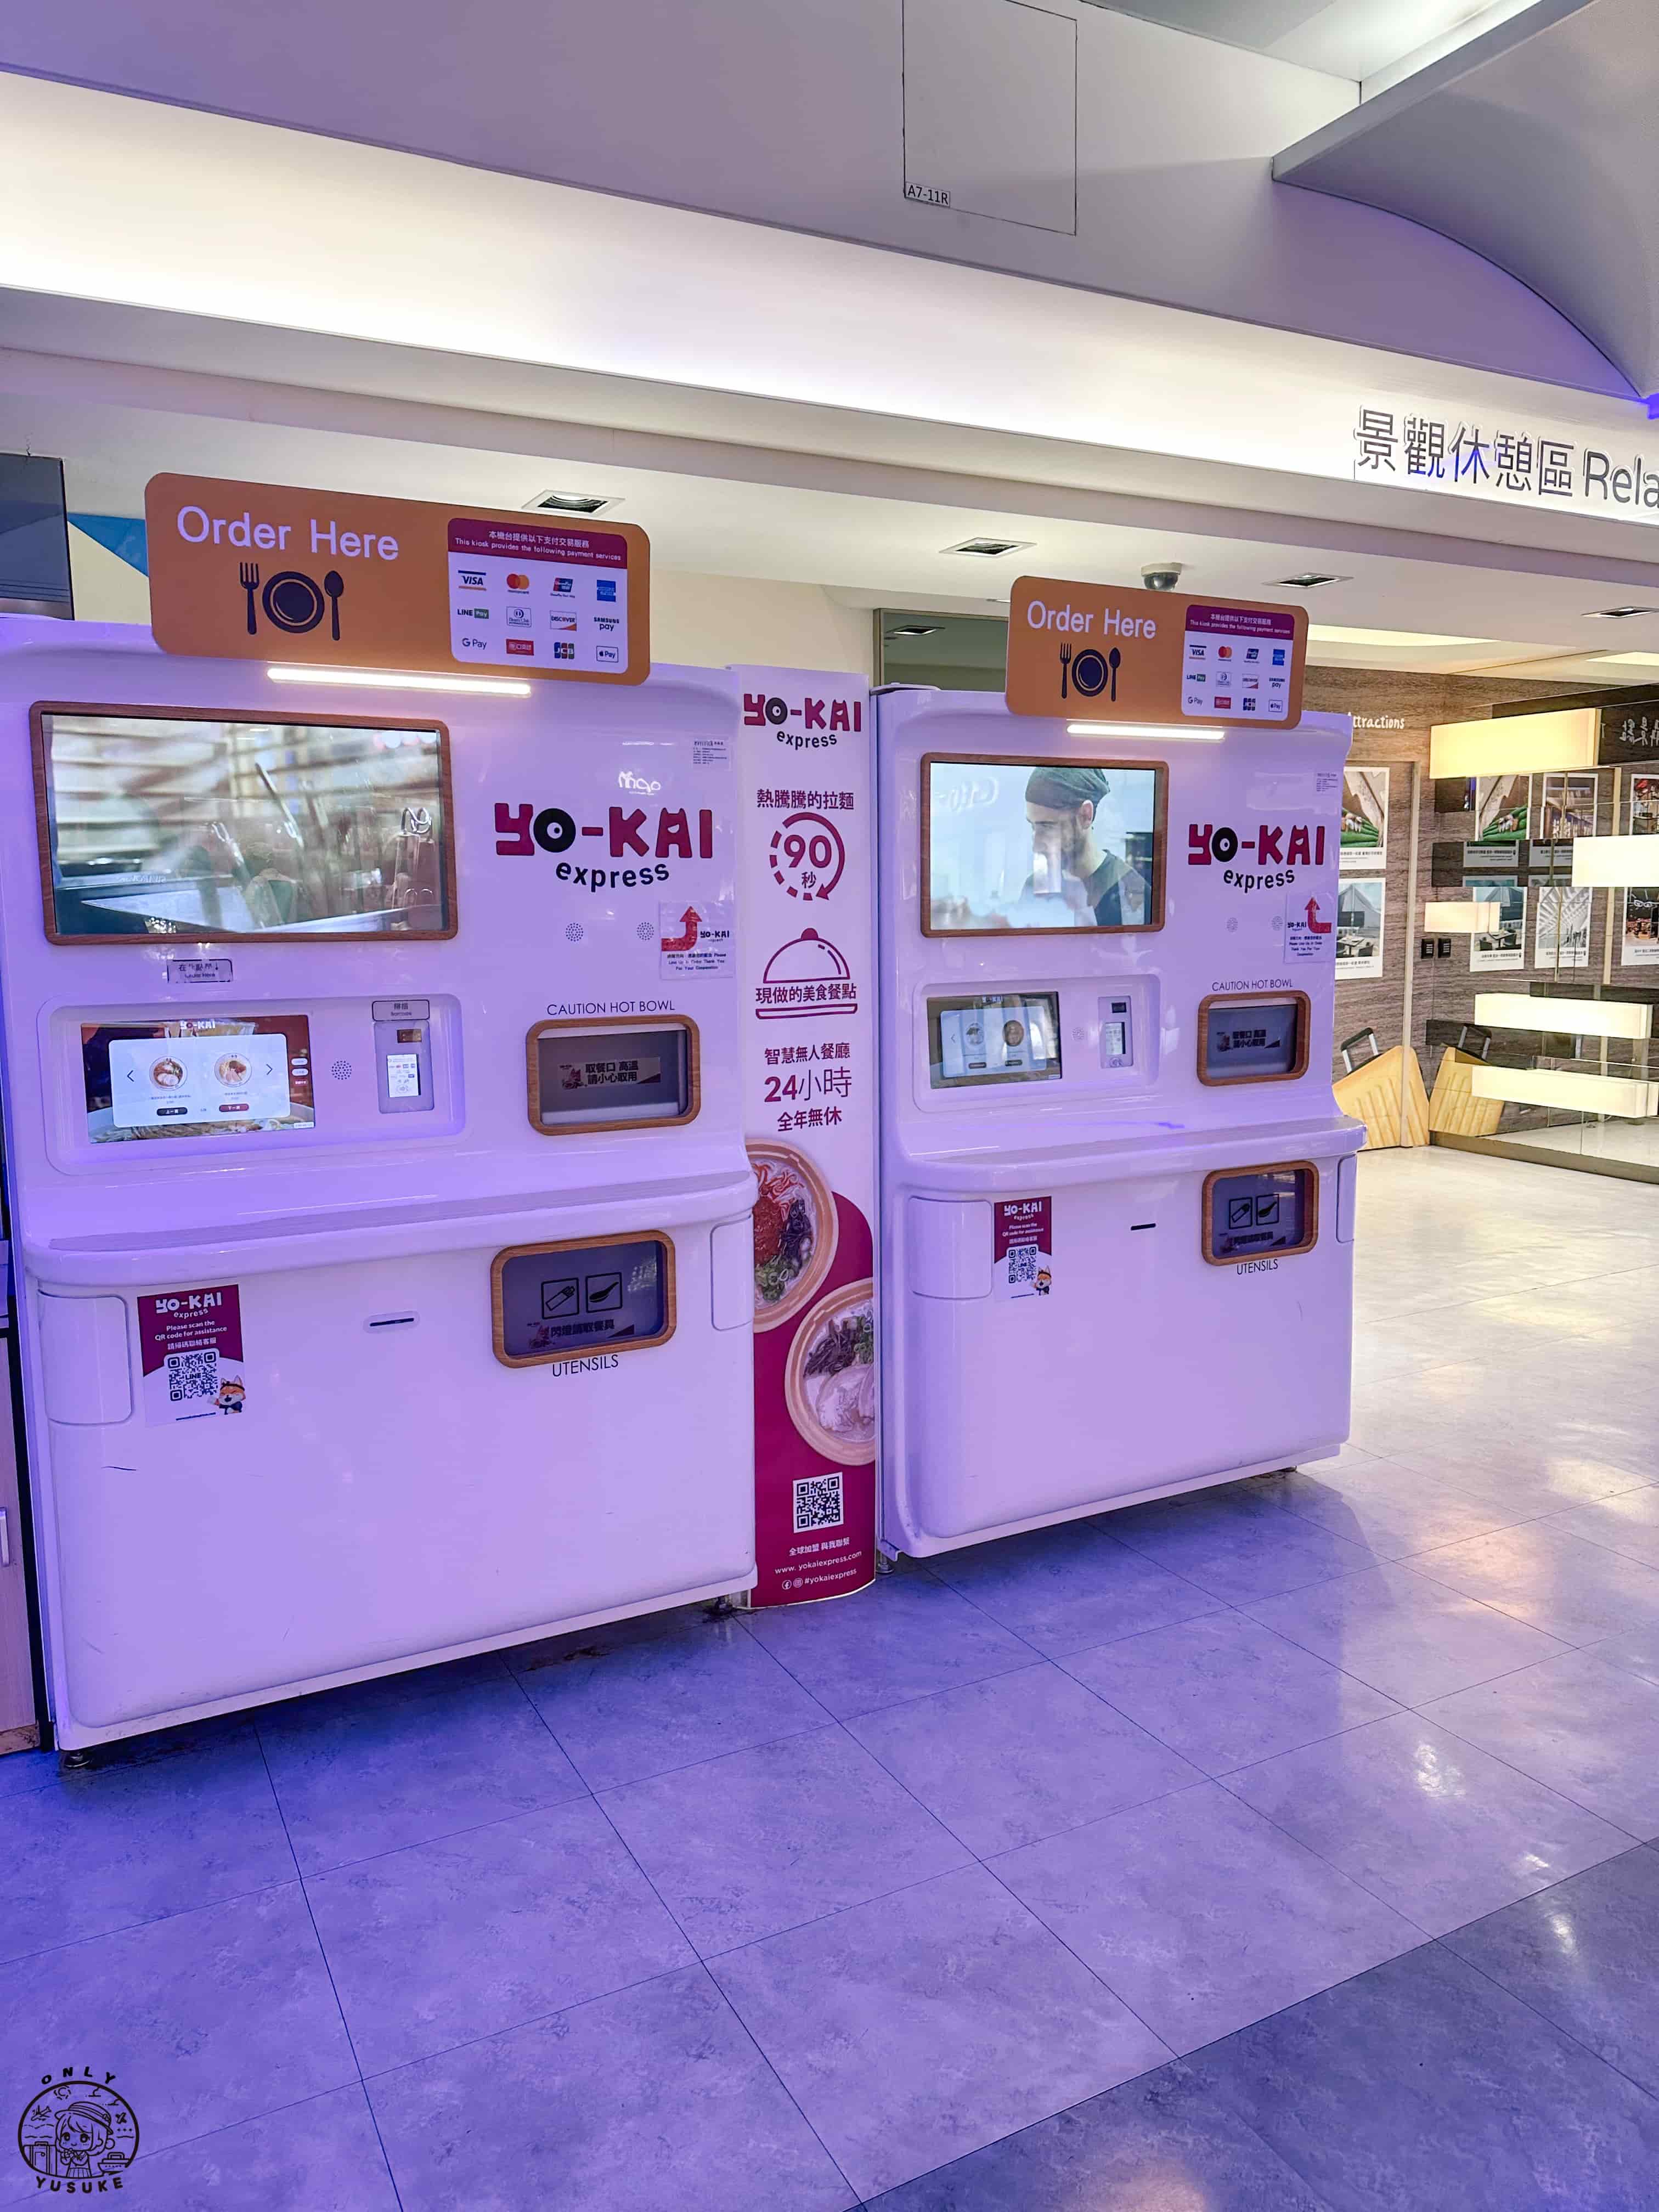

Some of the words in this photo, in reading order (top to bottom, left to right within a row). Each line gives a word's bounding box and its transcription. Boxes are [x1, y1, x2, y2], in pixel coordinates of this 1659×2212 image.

[907, 185, 949, 205] A7-11R
[1356, 409, 1574, 496] 景觀休憩區
[1585, 451, 1659, 507] Rela
[177, 504, 291, 550] Order
[311, 519, 399, 561] Here
[488, 531, 590, 549] 本機台提供以下支付交易服務
[455, 537, 470, 546] This
[471, 539, 489, 548] kiosk
[491, 542, 520, 551] provides
[567, 550, 594, 558] payment
[461, 575, 483, 585] VISA
[599, 623, 614, 631] pay
[1027, 600, 1093, 634] Order
[1104, 608, 1156, 639] Here
[472, 639, 487, 650] Pay
[743, 693, 861, 732] YO-KAI
[1348, 712, 1405, 729] ttractions
[776, 731, 837, 751] express
[757, 788, 854, 810] 熱騰騰的拉麵
[494, 803, 713, 859] YO-KAI
[783, 834, 832, 868] 90
[1188, 824, 1325, 865] YO-KAI
[556, 861, 669, 893] express
[802, 871, 816, 888] 秒
[1223, 869, 1295, 894] express
[755, 983, 857, 1004] 現做的美食餐點
[1212, 980, 1249, 991] CAUTION
[1251, 979, 1268, 989] HOT
[1270, 979, 1293, 988] BOWL
[547, 1002, 606, 1015] CAUTION
[610, 1001, 636, 1013] HOT
[639, 1000, 675, 1012] BOWL
[764, 1042, 850, 1065] 智慧無人餐廳
[585, 1062, 616, 1073] 取餐口
[764, 1066, 852, 1103] 24小時
[777, 1106, 842, 1132] 全年無休
[1004, 1201, 1042, 1216] YO-KAI
[1237, 1259, 1278, 1276] UTENSILS
[155, 1291, 222, 1314] YO-KAI
[173, 1308, 208, 1319] express
[194, 1327, 228, 1335] assistance
[552, 1354, 619, 1377] UTENSILS
[789, 1543, 819, 1556] 全球加盟
[775, 1566, 796, 1575] www.
[798, 1551, 862, 1571] yokaiexpress.com
[804, 1568, 857, 1585] #yokaiexpress
